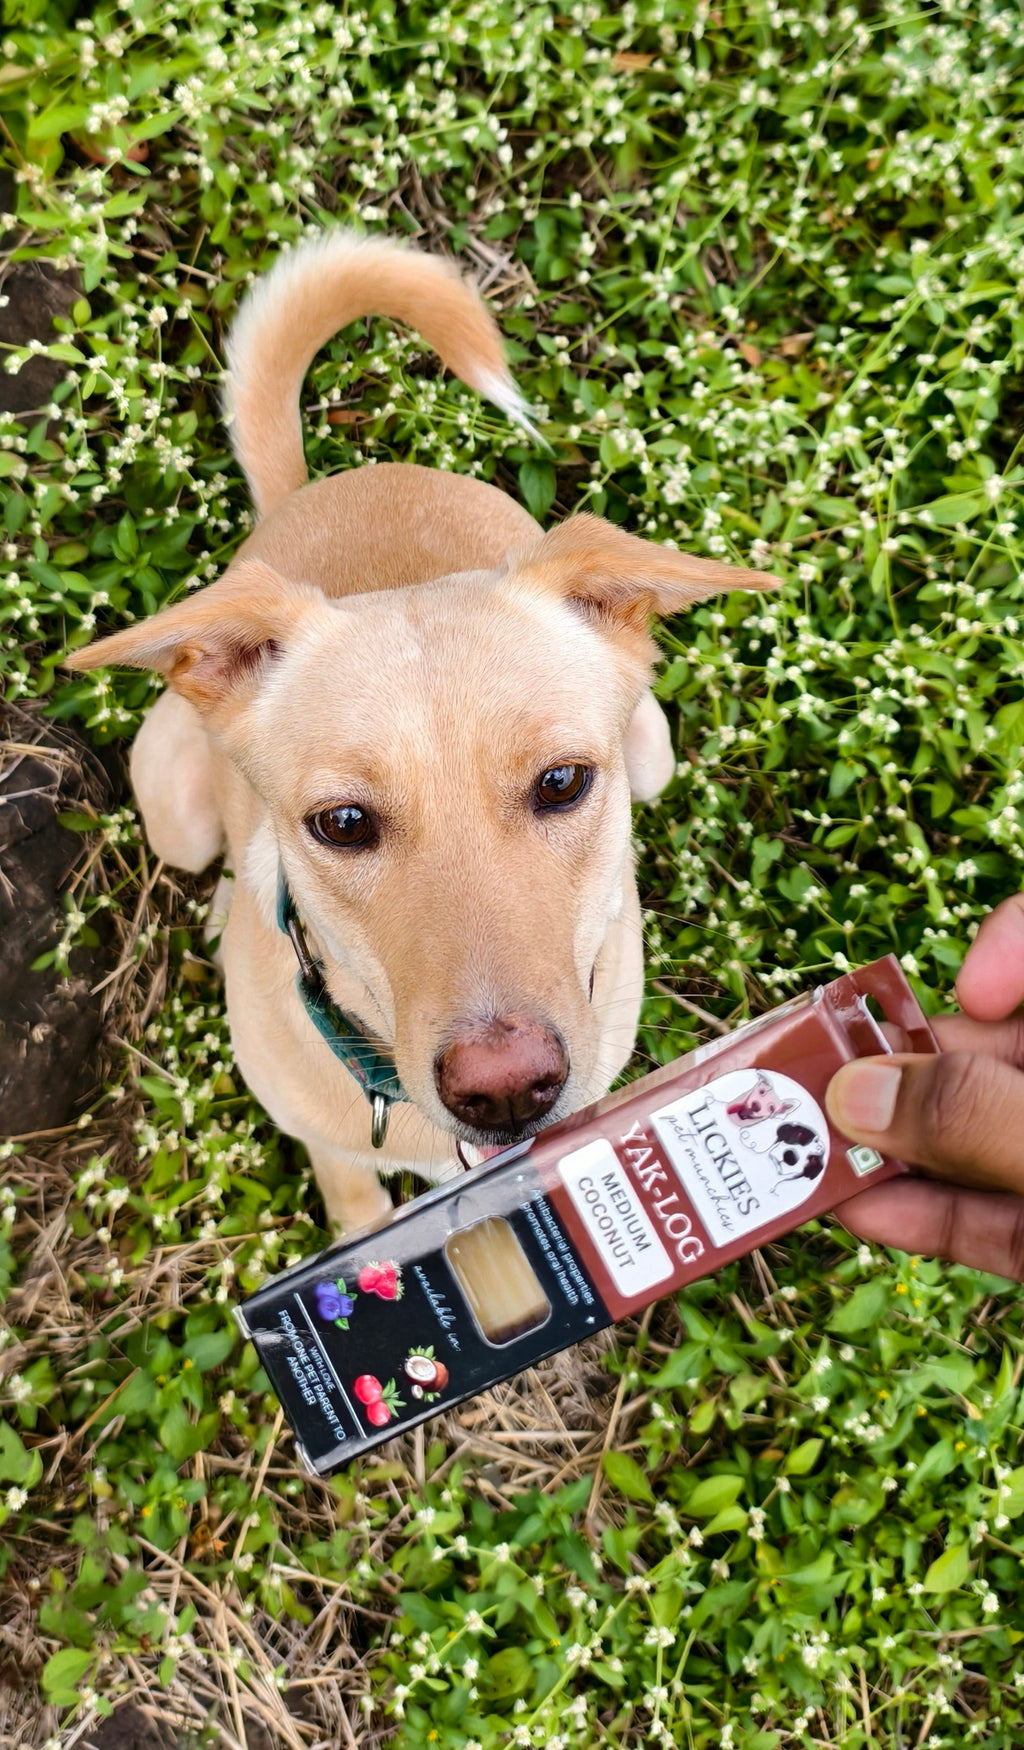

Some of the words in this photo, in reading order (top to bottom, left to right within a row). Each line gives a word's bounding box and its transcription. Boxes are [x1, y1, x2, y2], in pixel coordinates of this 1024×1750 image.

[659, 1114, 698, 1146] pet
[688, 1104, 760, 1216] LICKIES
[577, 1177, 636, 1268] COCONUT
[601, 1171, 651, 1252] MEDIUM
[620, 1120, 705, 1265] YAK-LOG
[520, 1201, 552, 1251] promotes
[546, 1250, 565, 1272] oral
[557, 1270, 579, 1306] health
[531, 1189, 570, 1253] Antibacterial
[561, 1252, 595, 1306] properties
[413, 1265, 456, 1329] available
[278, 1309, 298, 1339] FROM
[293, 1340, 311, 1365] ONE
[304, 1364, 318, 1384] PET
[315, 1381, 340, 1422] PARENT
[331, 1422, 347, 1441] TO
[286, 1356, 317, 1406] ANOTHER
[309, 1346, 325, 1368] WITH
